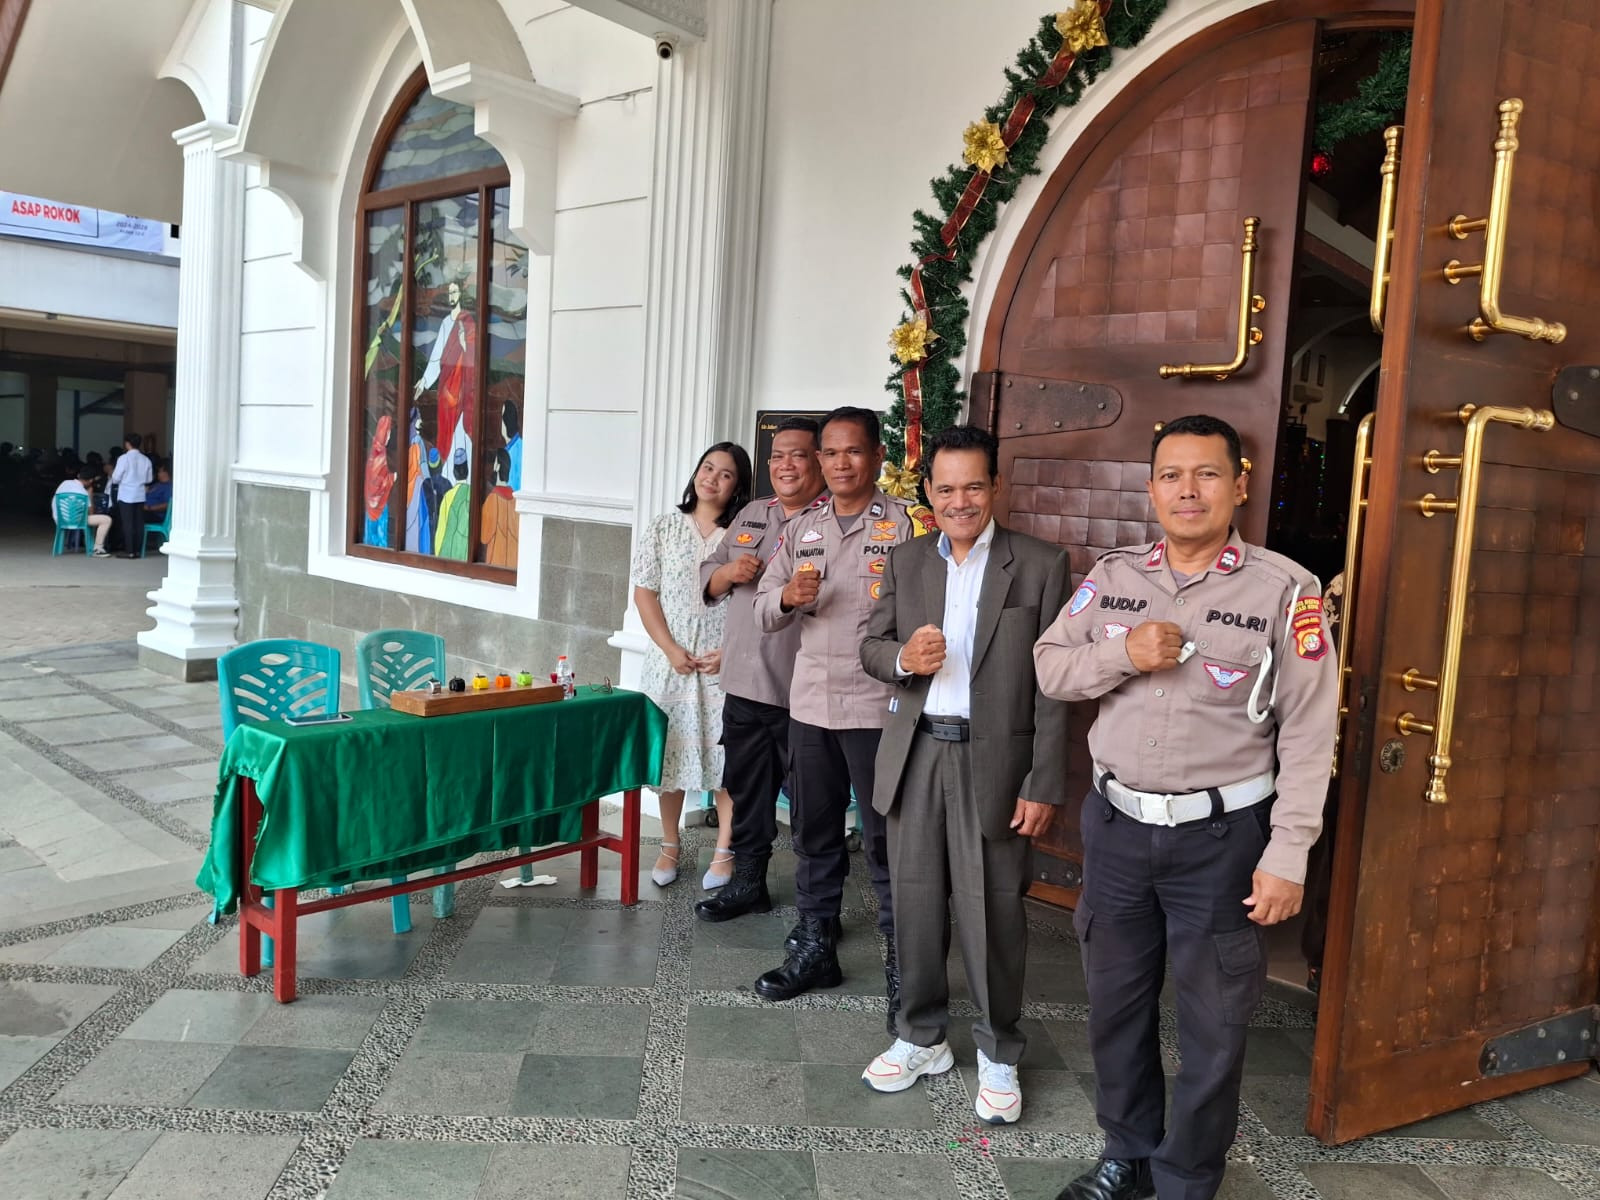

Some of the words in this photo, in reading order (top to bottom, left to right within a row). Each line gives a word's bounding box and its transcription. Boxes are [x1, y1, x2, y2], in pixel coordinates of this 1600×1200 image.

[12, 199, 41, 216] ASAP
[43, 205, 80, 223] ROKOK
[1206, 610, 1267, 632] POLRI
